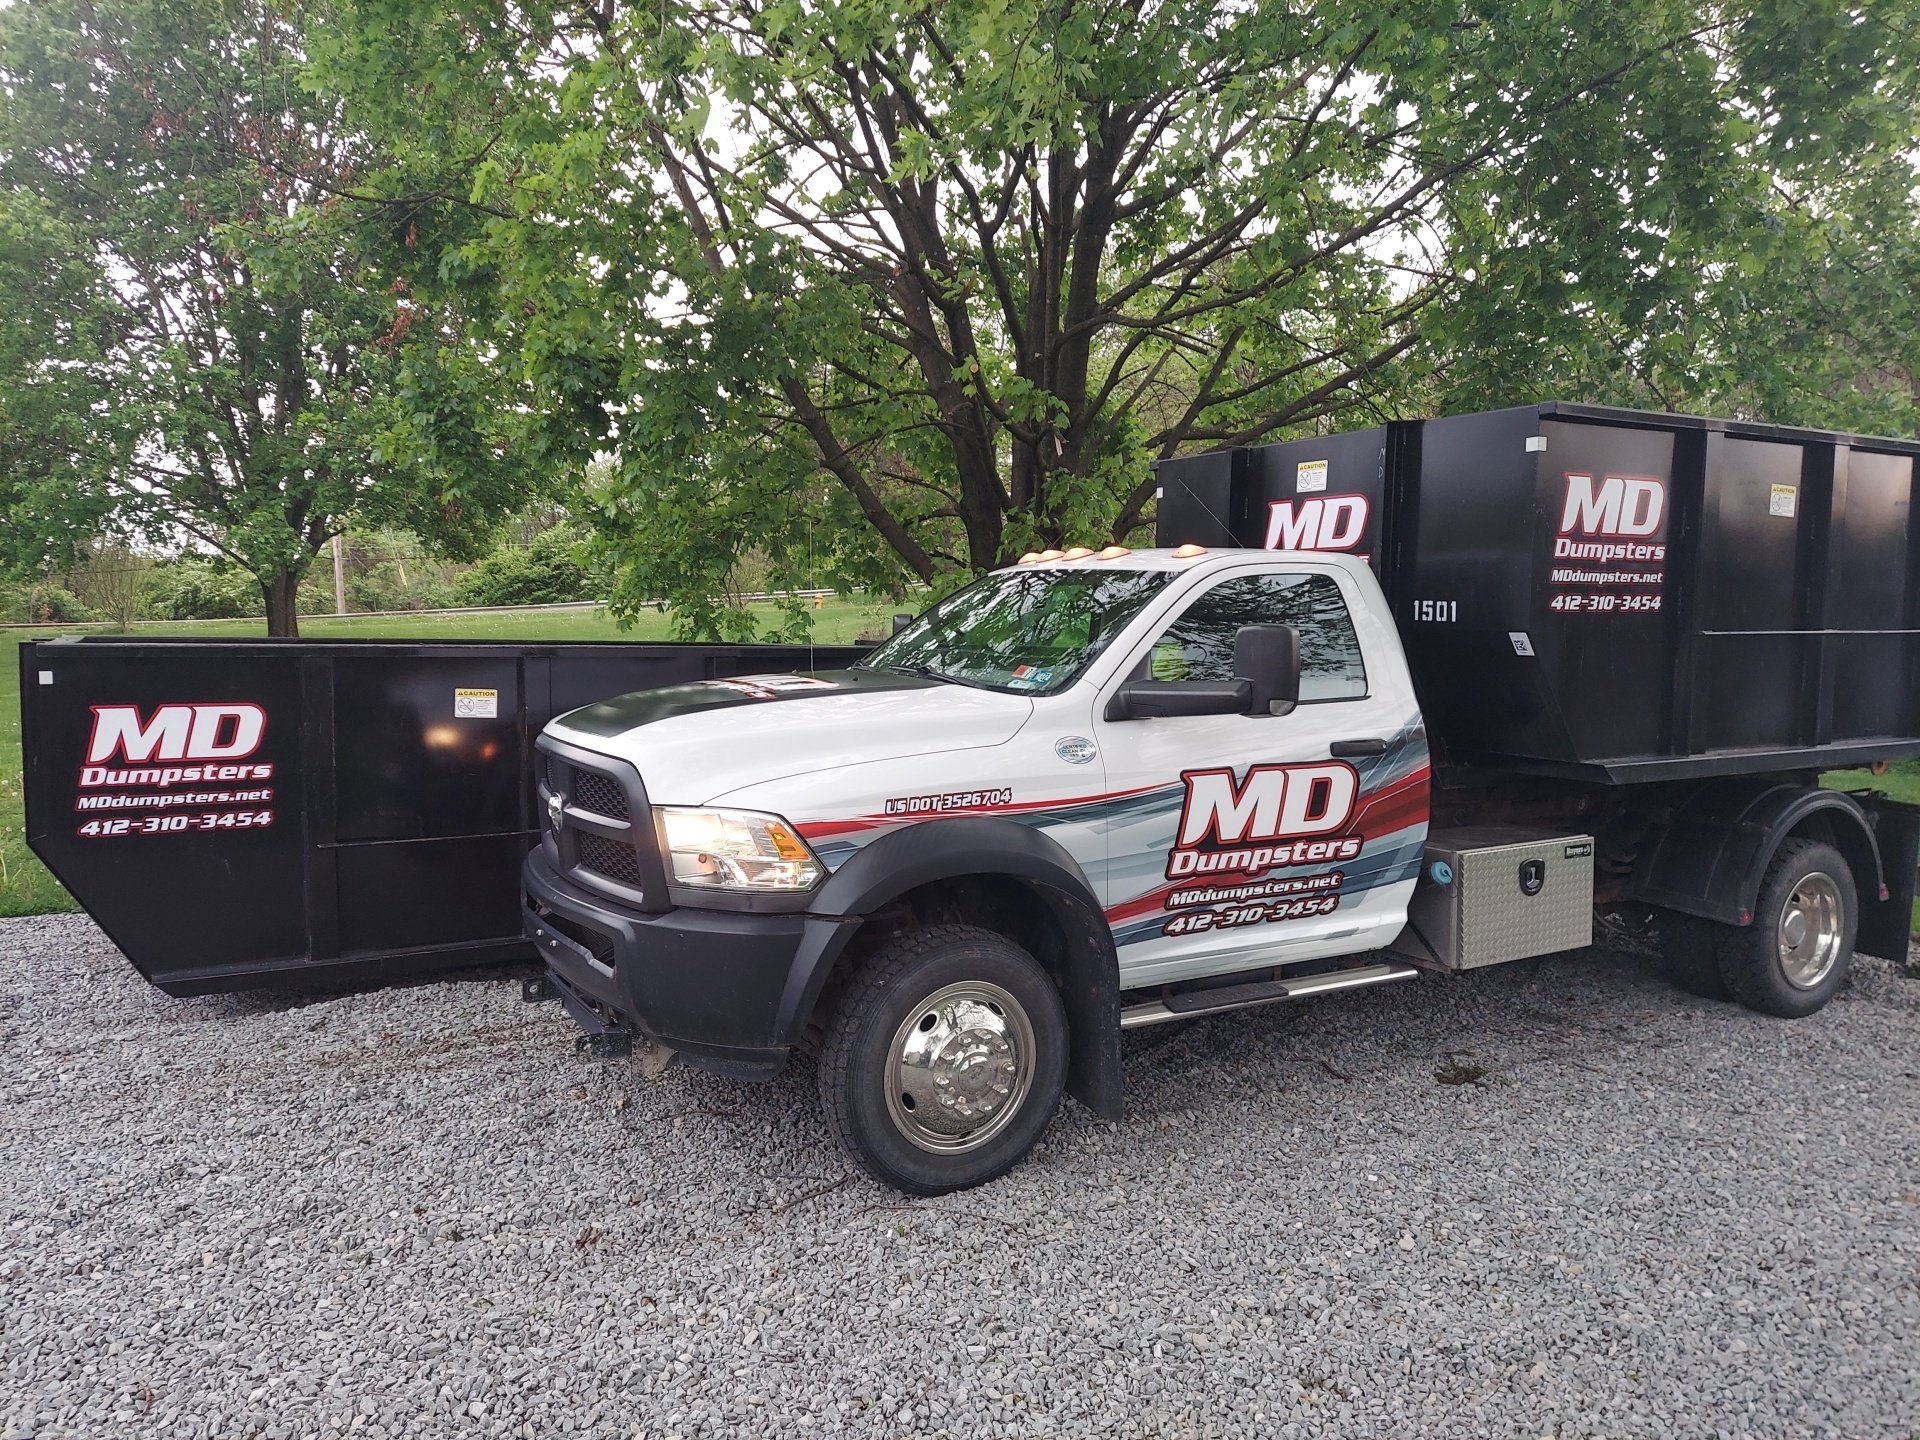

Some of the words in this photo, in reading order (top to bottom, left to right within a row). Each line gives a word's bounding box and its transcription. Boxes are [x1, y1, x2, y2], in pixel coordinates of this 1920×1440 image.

[1303, 462, 1327, 470] CAUTION
[1560, 474, 1665, 536] MD
[1265, 495, 1368, 550] MD
[1554, 538, 1666, 563] Dumpsters
[1551, 569, 1664, 585] MDdumpsters.net
[1413, 600, 1457, 623] 1501
[1550, 595, 1662, 611] 412-310-3454
[88, 704, 265, 764] MD
[80, 764, 273, 787] Dumpsters
[77, 789, 272, 809] MDdumpsters.net
[885, 799, 907, 814] US
[909, 797, 940, 812] DOT
[942, 788, 1011, 809] 3526704
[1181, 764, 1356, 846] MD
[79, 811, 272, 836] 412-310-3454
[1169, 838, 1361, 875] Dumpsters
[1168, 873, 1342, 907] MDdumpsters.net
[1166, 896, 1336, 933] 412-310-3454
